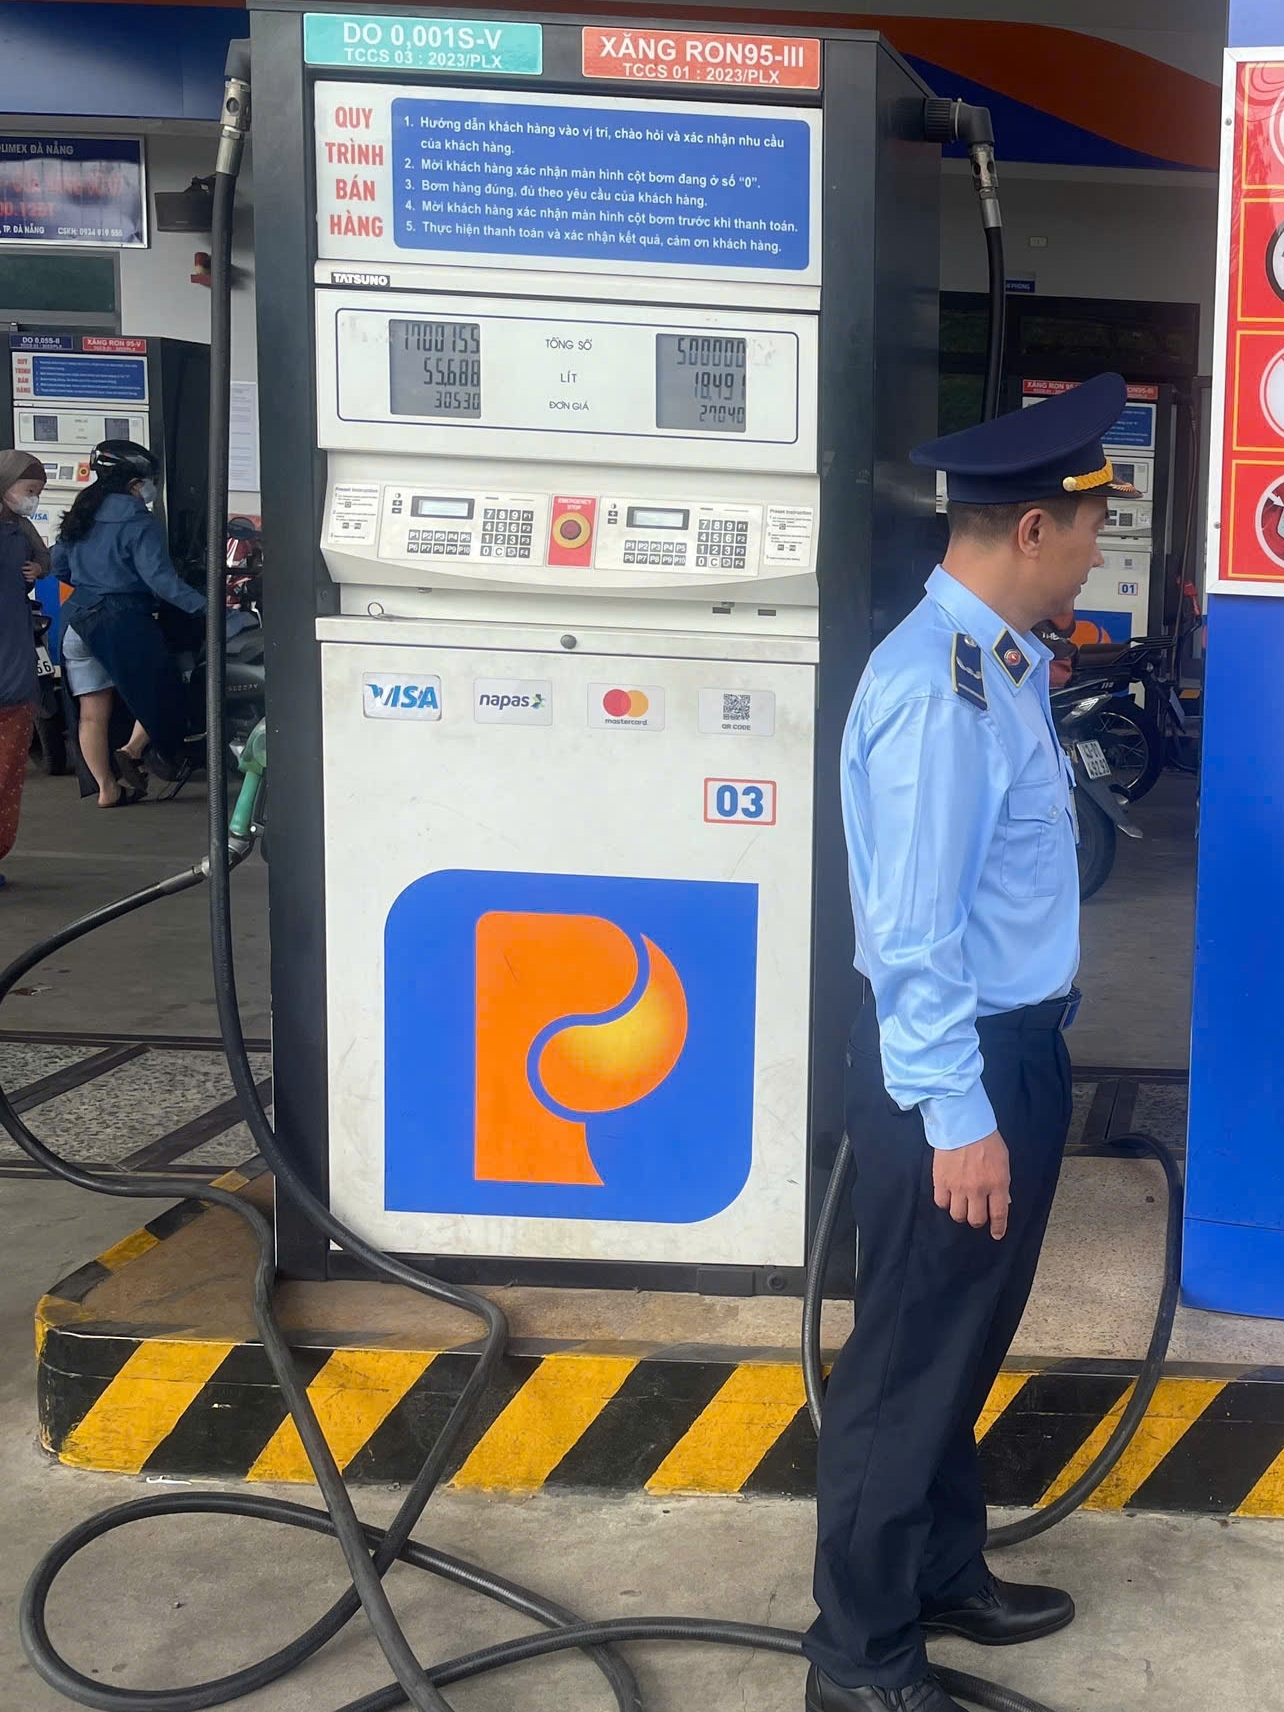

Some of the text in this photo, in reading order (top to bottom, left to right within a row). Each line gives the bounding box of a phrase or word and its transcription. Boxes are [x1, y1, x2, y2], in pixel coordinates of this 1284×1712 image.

[343, 22, 503, 52] DO 0,001S-V
[344, 49, 390, 65] TCCS
[394, 50, 414, 66] 03
[428, 52, 503, 70] 2023/PLX
[600, 34, 805, 68] XĂNG RON95-III
[623, 63, 669, 79] TCCS
[673, 65, 692, 80] 01
[706, 67, 780, 85] 2023/PLX
[334, 106, 373, 129] QUY
[404, 116, 785, 148] 1. Hướng dẫn khách hàng vào vị trí, chào hỏi và xác nhận nhu cầu
[325, 138, 384, 166] TRÌNH
[420, 137, 515, 156] của khách hàng.
[404, 158, 415, 169] 2.
[421, 158, 443, 171] Mời
[446, 160, 481, 173] khách
[484, 162, 513, 177] hàng
[516, 163, 536, 176] xác
[539, 165, 568, 179] nhận
[571, 166, 596, 179] màn
[599, 167, 624, 181] hình
[627, 168, 646, 184] cột
[649, 171, 675, 184] bơm
[678, 172, 707, 188] đang
[710, 171, 719, 186] ở
[721, 173, 736, 187] số
[335, 174, 375, 201] BÁN
[329, 210, 383, 237] HÀNG
[406, 220, 782, 255] 5. Thực hiện thanh toán và xác nhận kết quả, cảm ơn khách hàng.
[333, 273, 388, 286] TATSUNO
[545, 336, 593, 351] TỔNG SỐ
[677, 338, 745, 368] 500000
[561, 371, 578, 384] LÍT
[434, 391, 480, 410] 30530
[549, 399, 590, 412] ĐƠN GIÁ
[1121, 585, 1135, 594] 01
[366, 684, 439, 710] VISA
[479, 692, 530, 711] napas
[715, 784, 764, 819] 03
